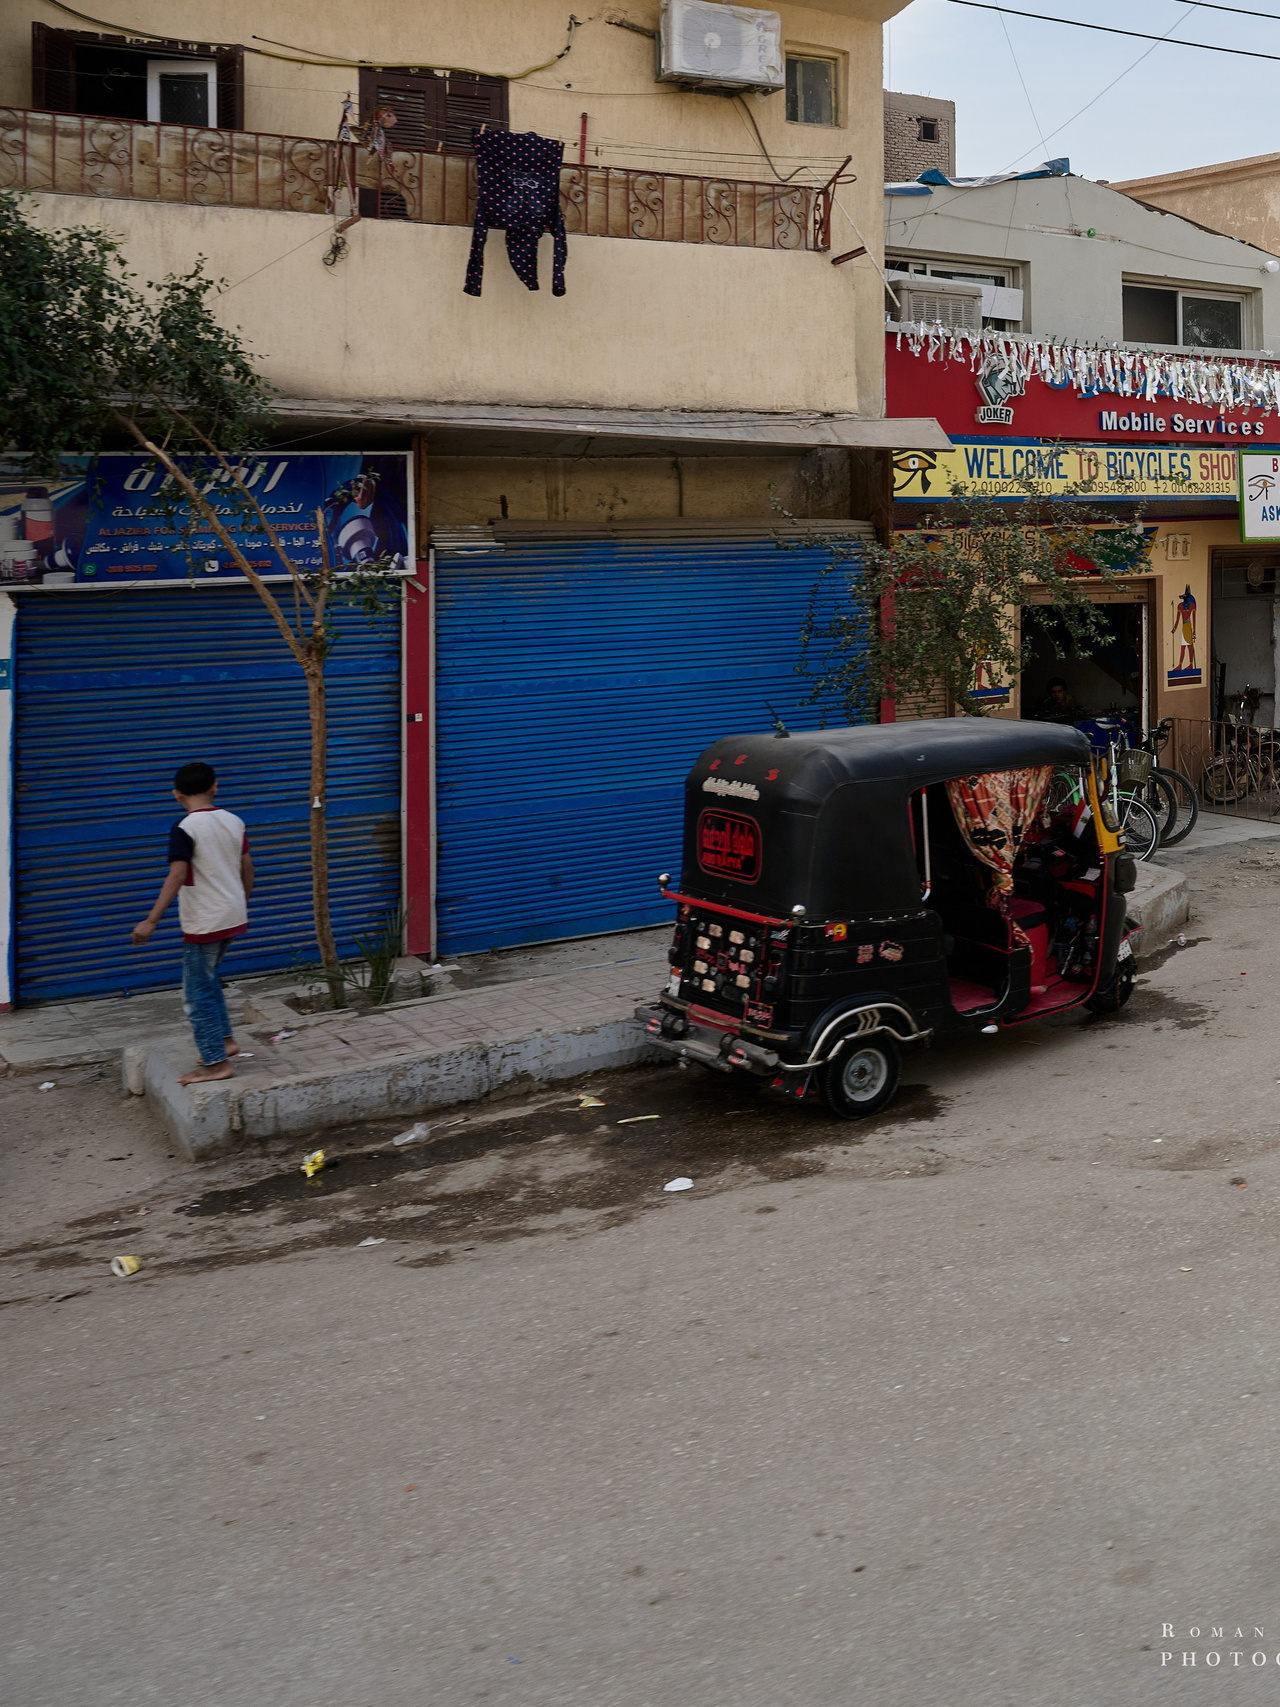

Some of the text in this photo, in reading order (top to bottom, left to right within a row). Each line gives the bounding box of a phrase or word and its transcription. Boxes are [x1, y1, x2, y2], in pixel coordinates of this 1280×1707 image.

[979, 406, 1013, 423] JOKER
[1100, 411, 1264, 435] Mobile Services
[964, 447, 1069, 480] WELCOME
[1075, 450, 1099, 481] TO
[981, 481, 1053, 494] 010022710
[98, 527, 151, 537] ALJAZIRA
[270, 522, 317, 533] SERVICES
